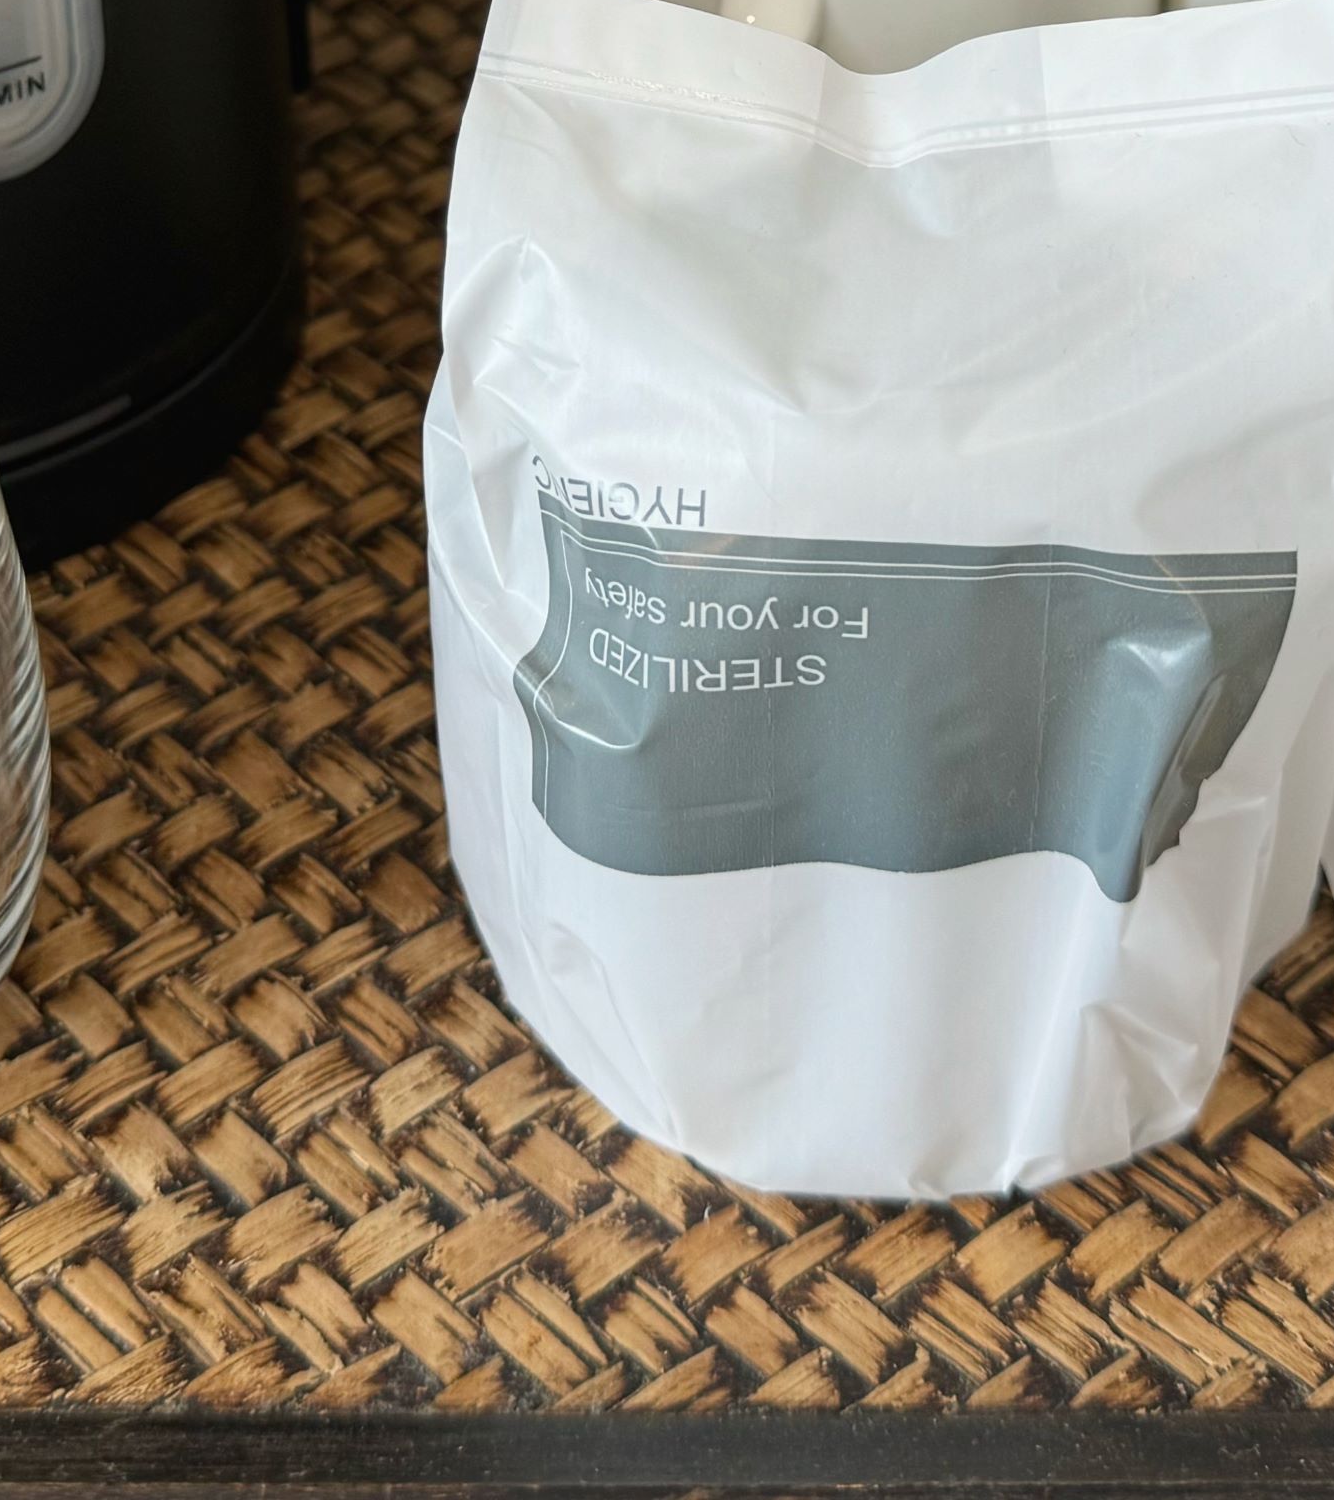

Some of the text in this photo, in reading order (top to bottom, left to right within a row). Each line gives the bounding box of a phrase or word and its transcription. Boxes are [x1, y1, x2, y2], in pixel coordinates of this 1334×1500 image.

[585, 567, 869, 639] For your safety
[589, 627, 827, 693] STERILIZED
